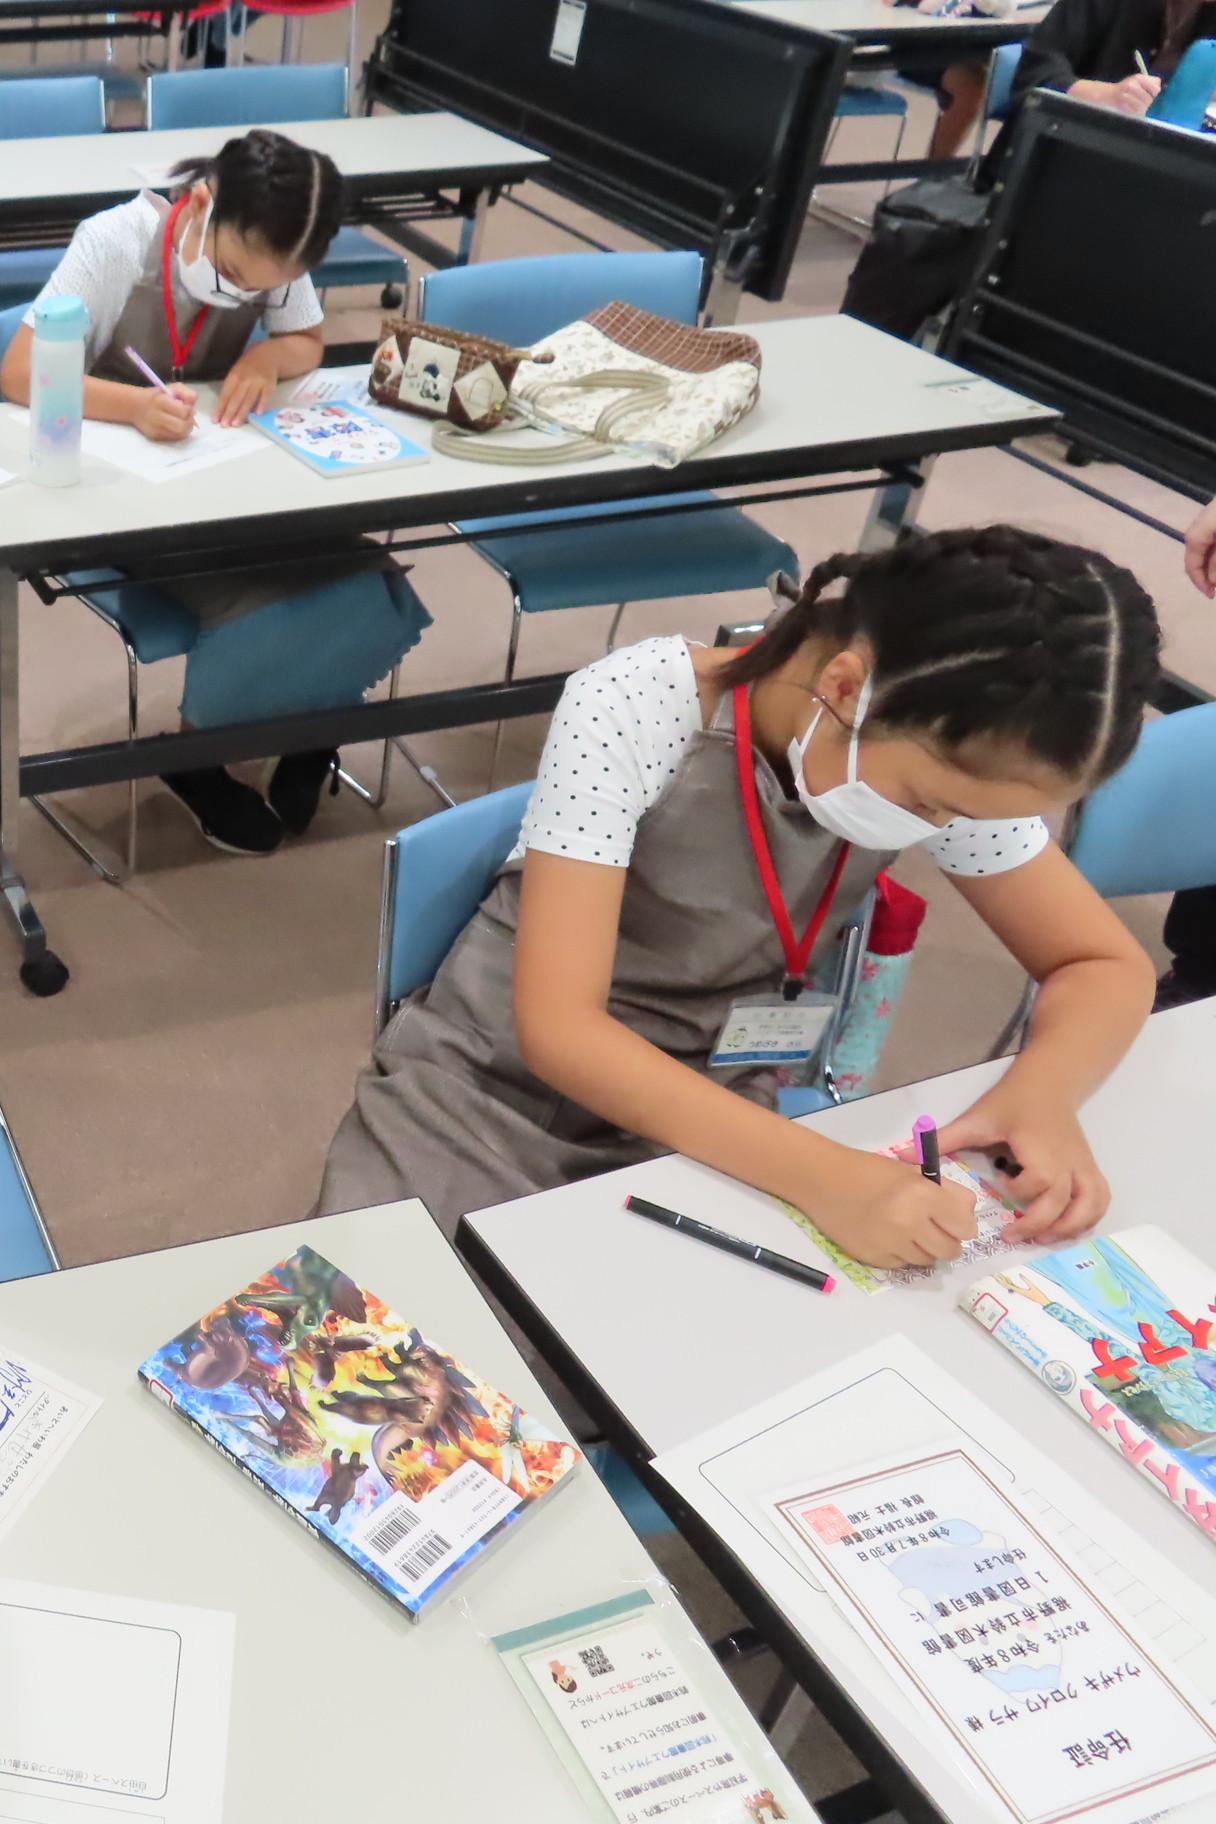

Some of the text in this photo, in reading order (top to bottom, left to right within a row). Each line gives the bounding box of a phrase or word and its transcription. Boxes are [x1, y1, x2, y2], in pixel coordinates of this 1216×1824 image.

[1091, 1294, 1216, 1382] イアナ
[973, 1547, 1028, 1574] 任命します
[921, 1595, 1072, 1656] 裾野市立鈴木図書館
[1083, 1661, 1141, 1692] ウメザキ
[964, 1715, 984, 1733] 様
[989, 1704, 1019, 1726] サラ
[1061, 1729, 1132, 1769] 任命証
